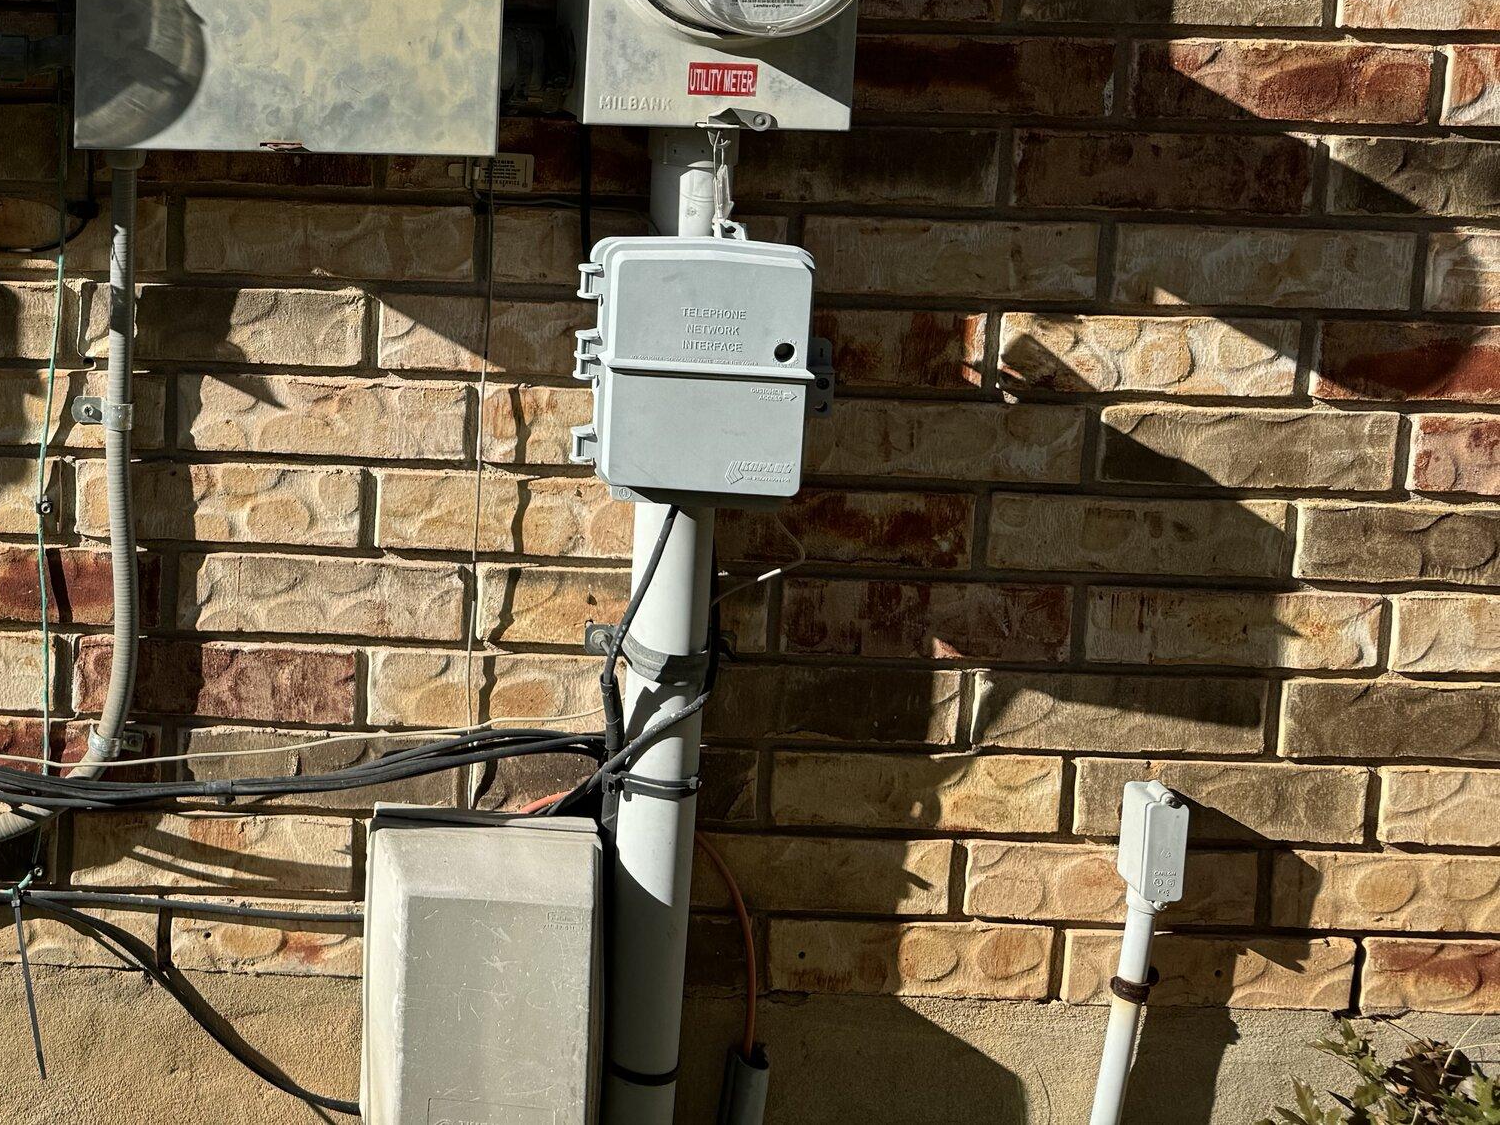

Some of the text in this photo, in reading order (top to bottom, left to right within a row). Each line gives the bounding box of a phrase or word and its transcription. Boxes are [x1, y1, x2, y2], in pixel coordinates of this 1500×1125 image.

[689, 68, 754, 94] UTILITY METER
[599, 94, 675, 111] MILBANK
[681, 306, 747, 321] TELEPHONE
[686, 324, 741, 336] NETWORK
[681, 339, 744, 353] INTERFACE
